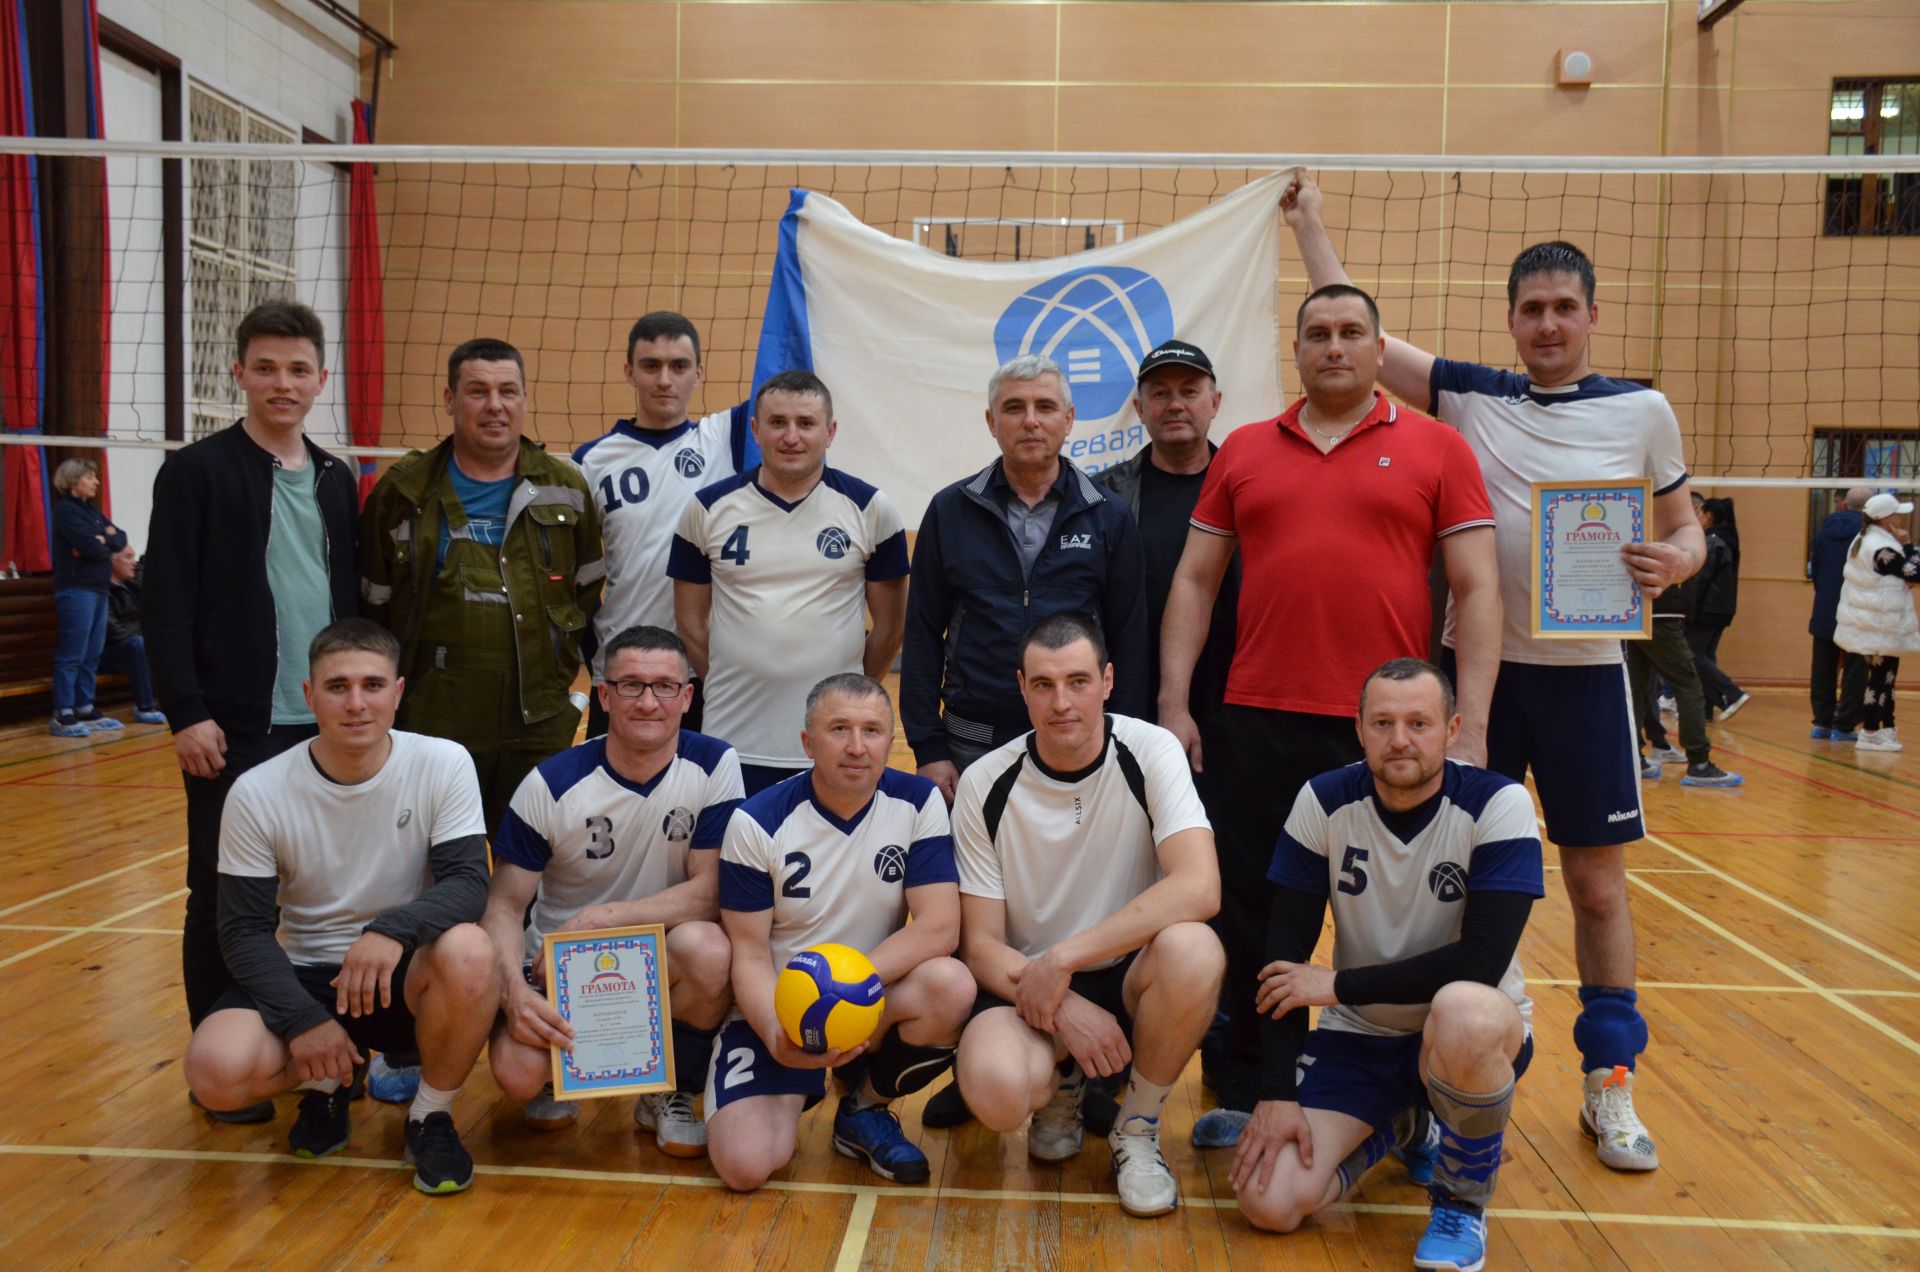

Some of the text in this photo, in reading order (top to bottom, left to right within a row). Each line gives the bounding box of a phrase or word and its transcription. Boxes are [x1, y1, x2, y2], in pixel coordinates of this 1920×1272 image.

[1063, 425, 1143, 457] евая
[599, 466, 650, 514] 10
[720, 525, 751, 566] 4
[1060, 534, 1091, 545] EA7
[1566, 531, 1621, 541] ГРАМОТА
[586, 816, 615, 859] 3
[782, 851, 811, 898] 2
[1337, 845, 1369, 896] 5
[581, 981, 636, 994] ГРАМОТА
[724, 1047, 755, 1089] 2
